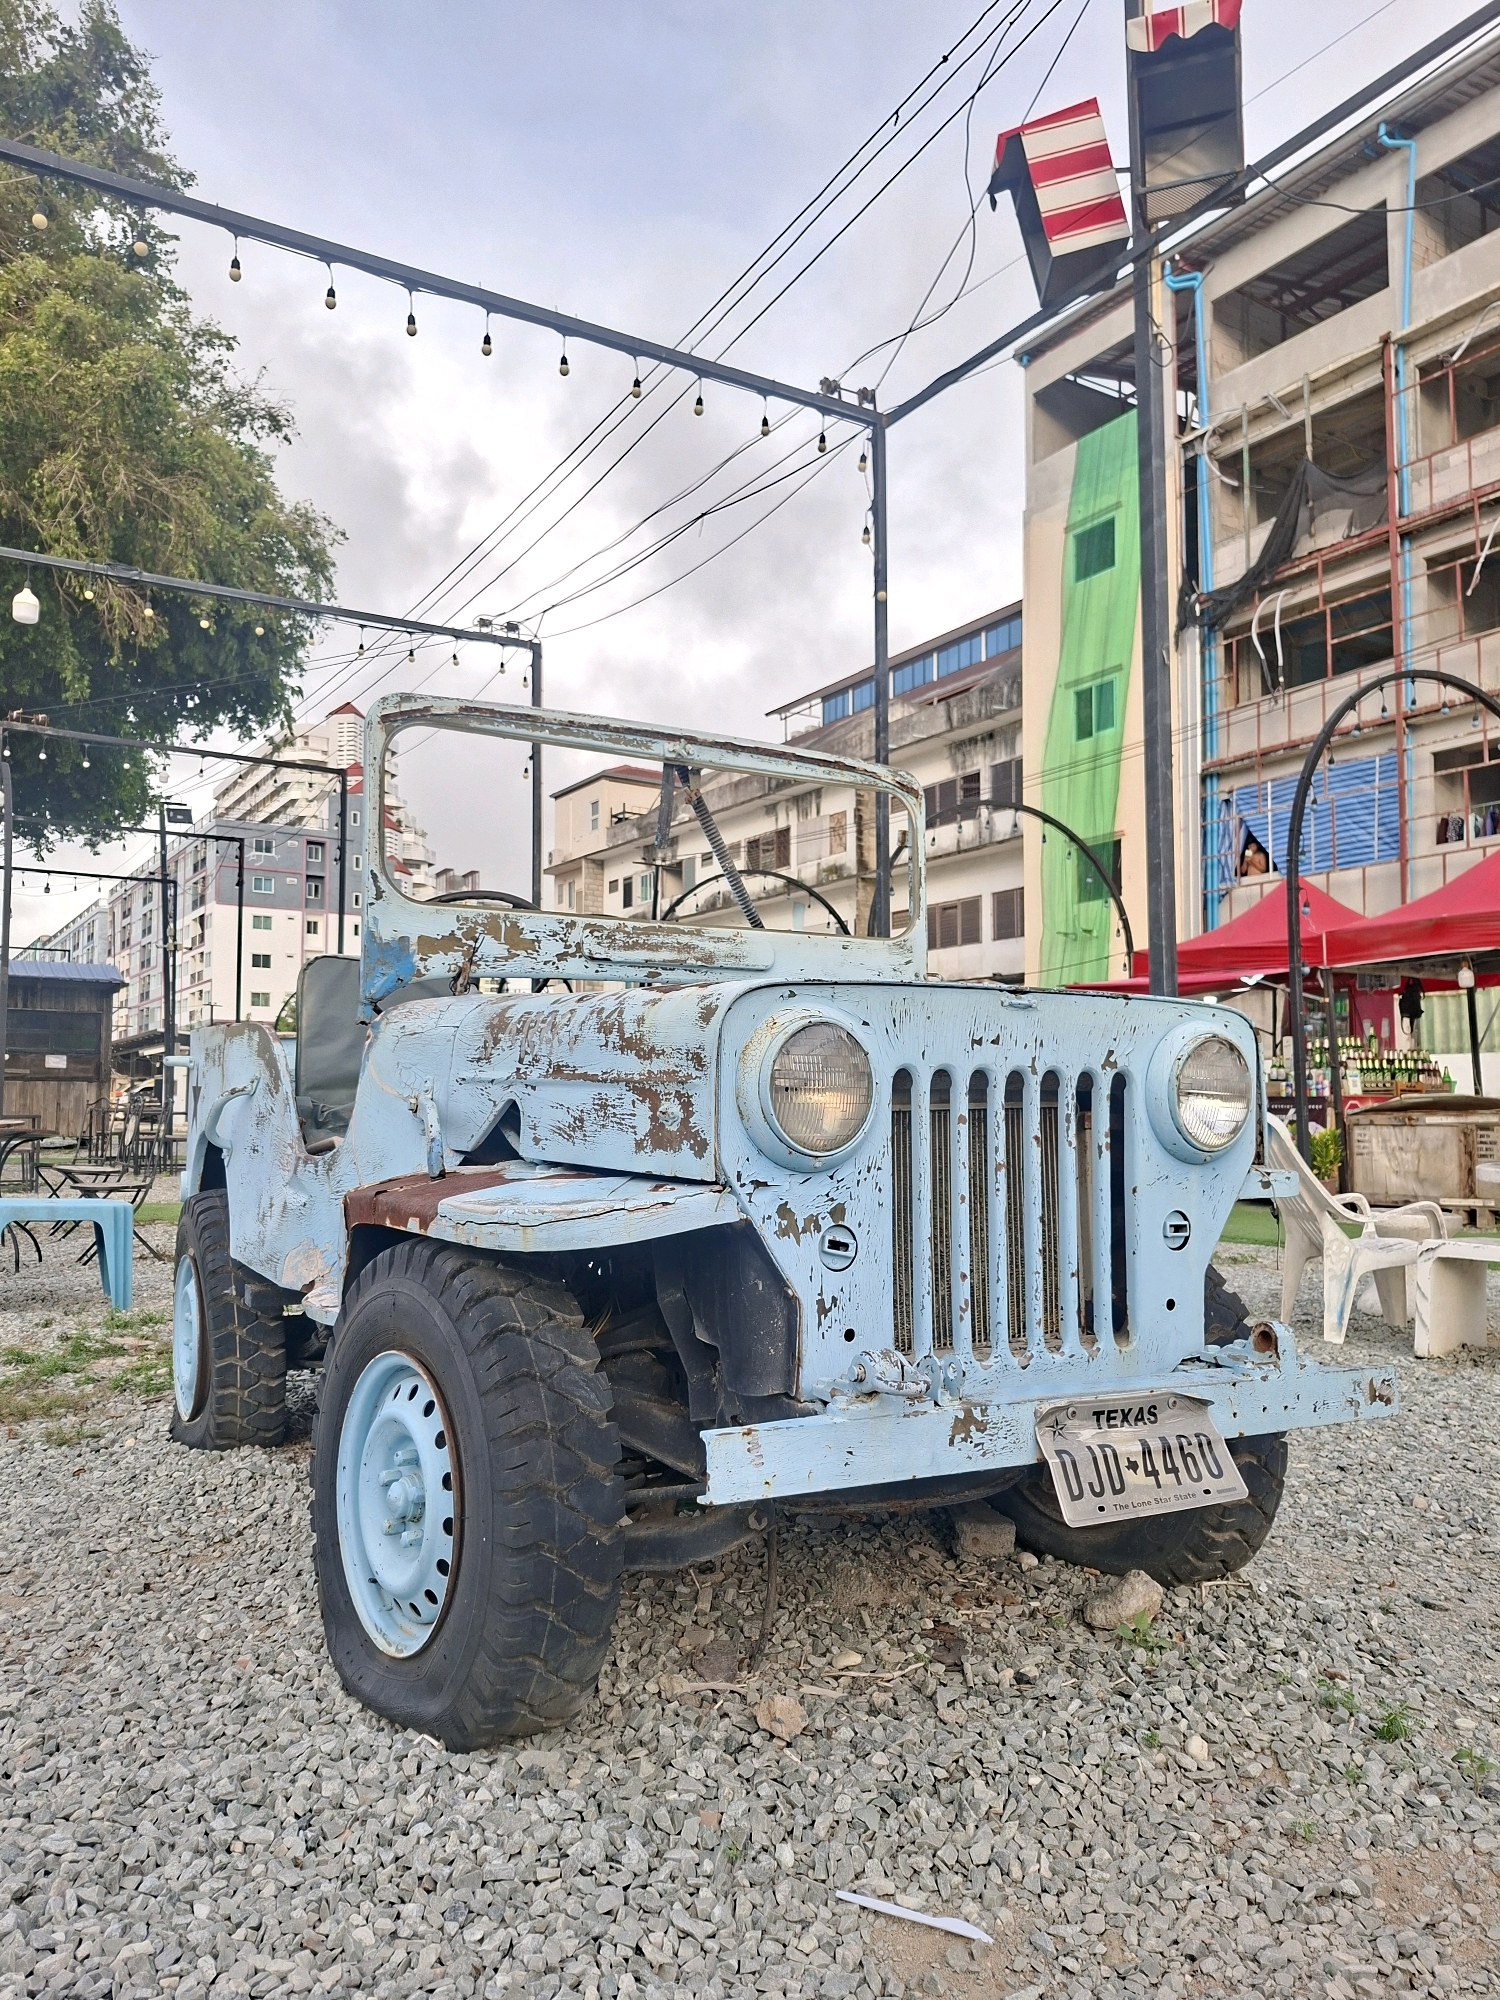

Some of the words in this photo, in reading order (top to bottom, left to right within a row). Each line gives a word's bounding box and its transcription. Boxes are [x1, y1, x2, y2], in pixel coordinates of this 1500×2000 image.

[1092, 1404, 1158, 1430] TEXAS
[1054, 1443, 1126, 1502] DJD
[1138, 1432, 1224, 1490] 4460
[1113, 1503, 1130, 1511] The
[1131, 1500, 1152, 1508] Lone
[1154, 1497, 1172, 1505] Star
[1173, 1493, 1197, 1501] State
